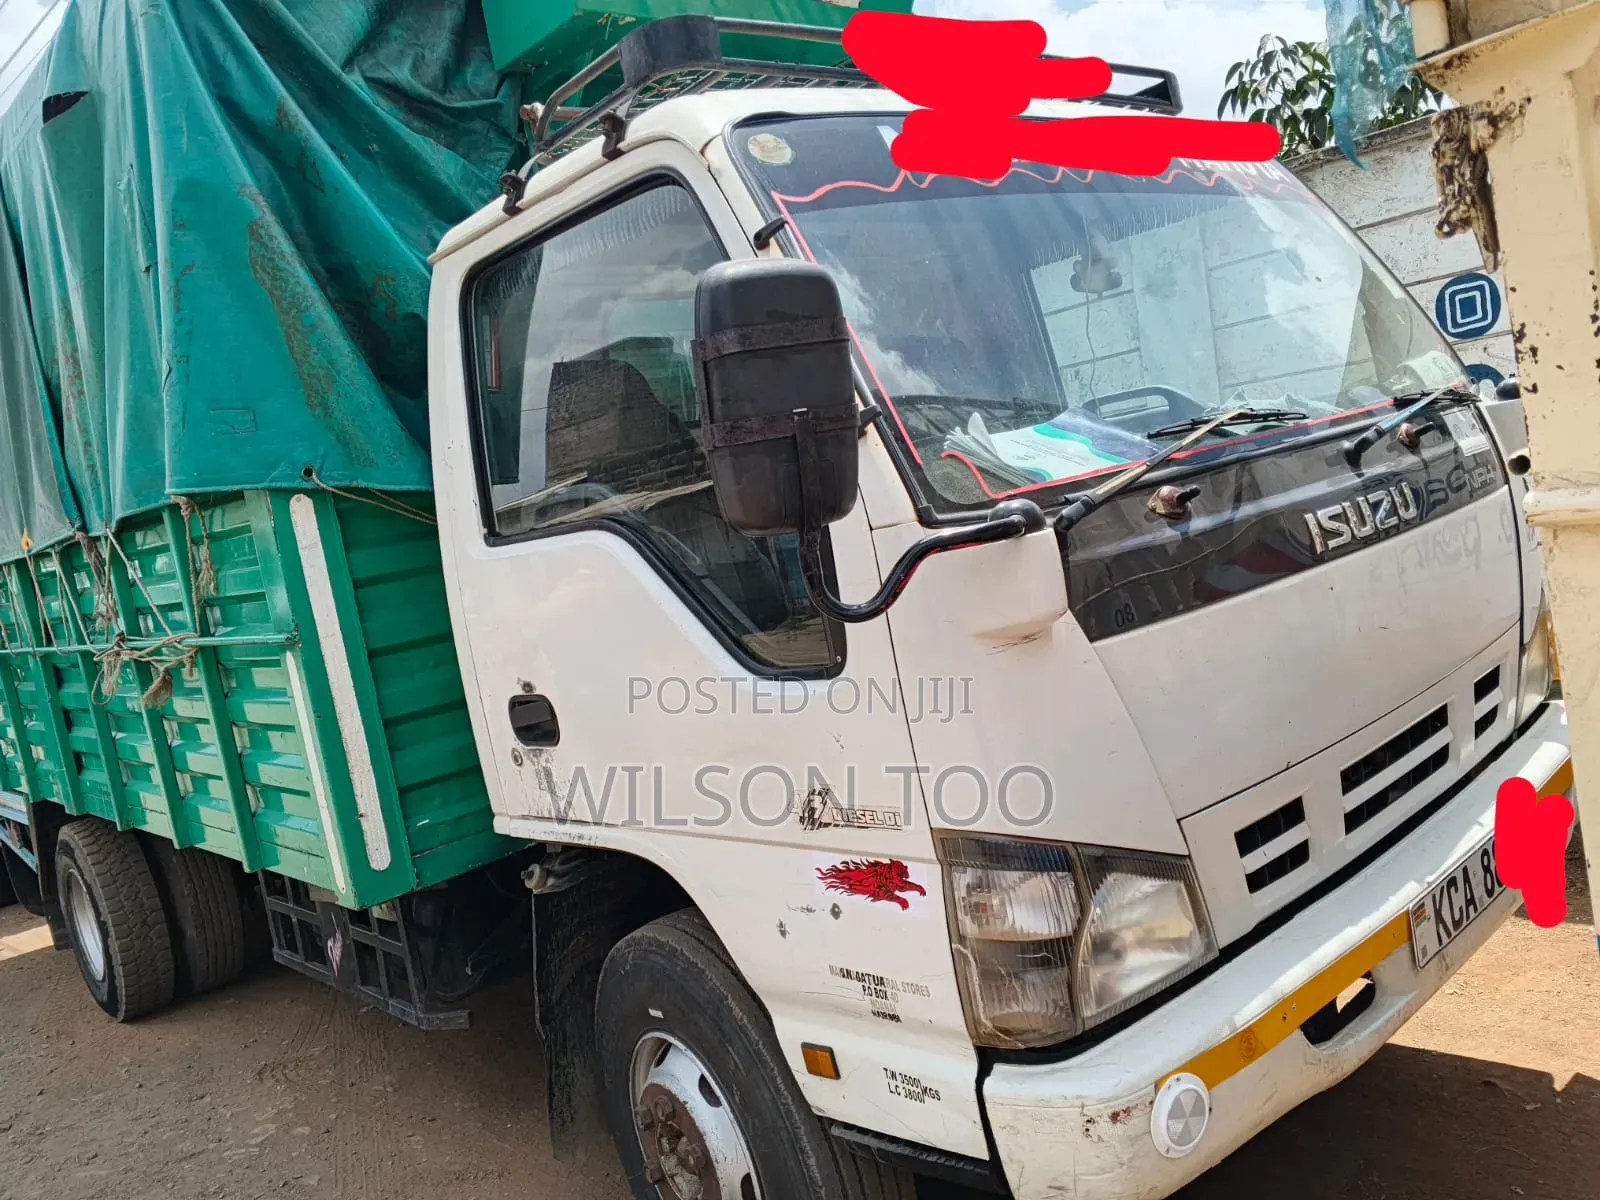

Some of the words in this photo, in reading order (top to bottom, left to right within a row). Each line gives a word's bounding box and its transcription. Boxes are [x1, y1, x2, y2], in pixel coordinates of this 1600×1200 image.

[1304, 482, 1418, 554] ISUZU
[1114, 605, 1135, 628] 08
[1432, 865, 1478, 947] KCA
[874, 987, 889, 1002] BOX
[922, 1085, 941, 1101] KGS
